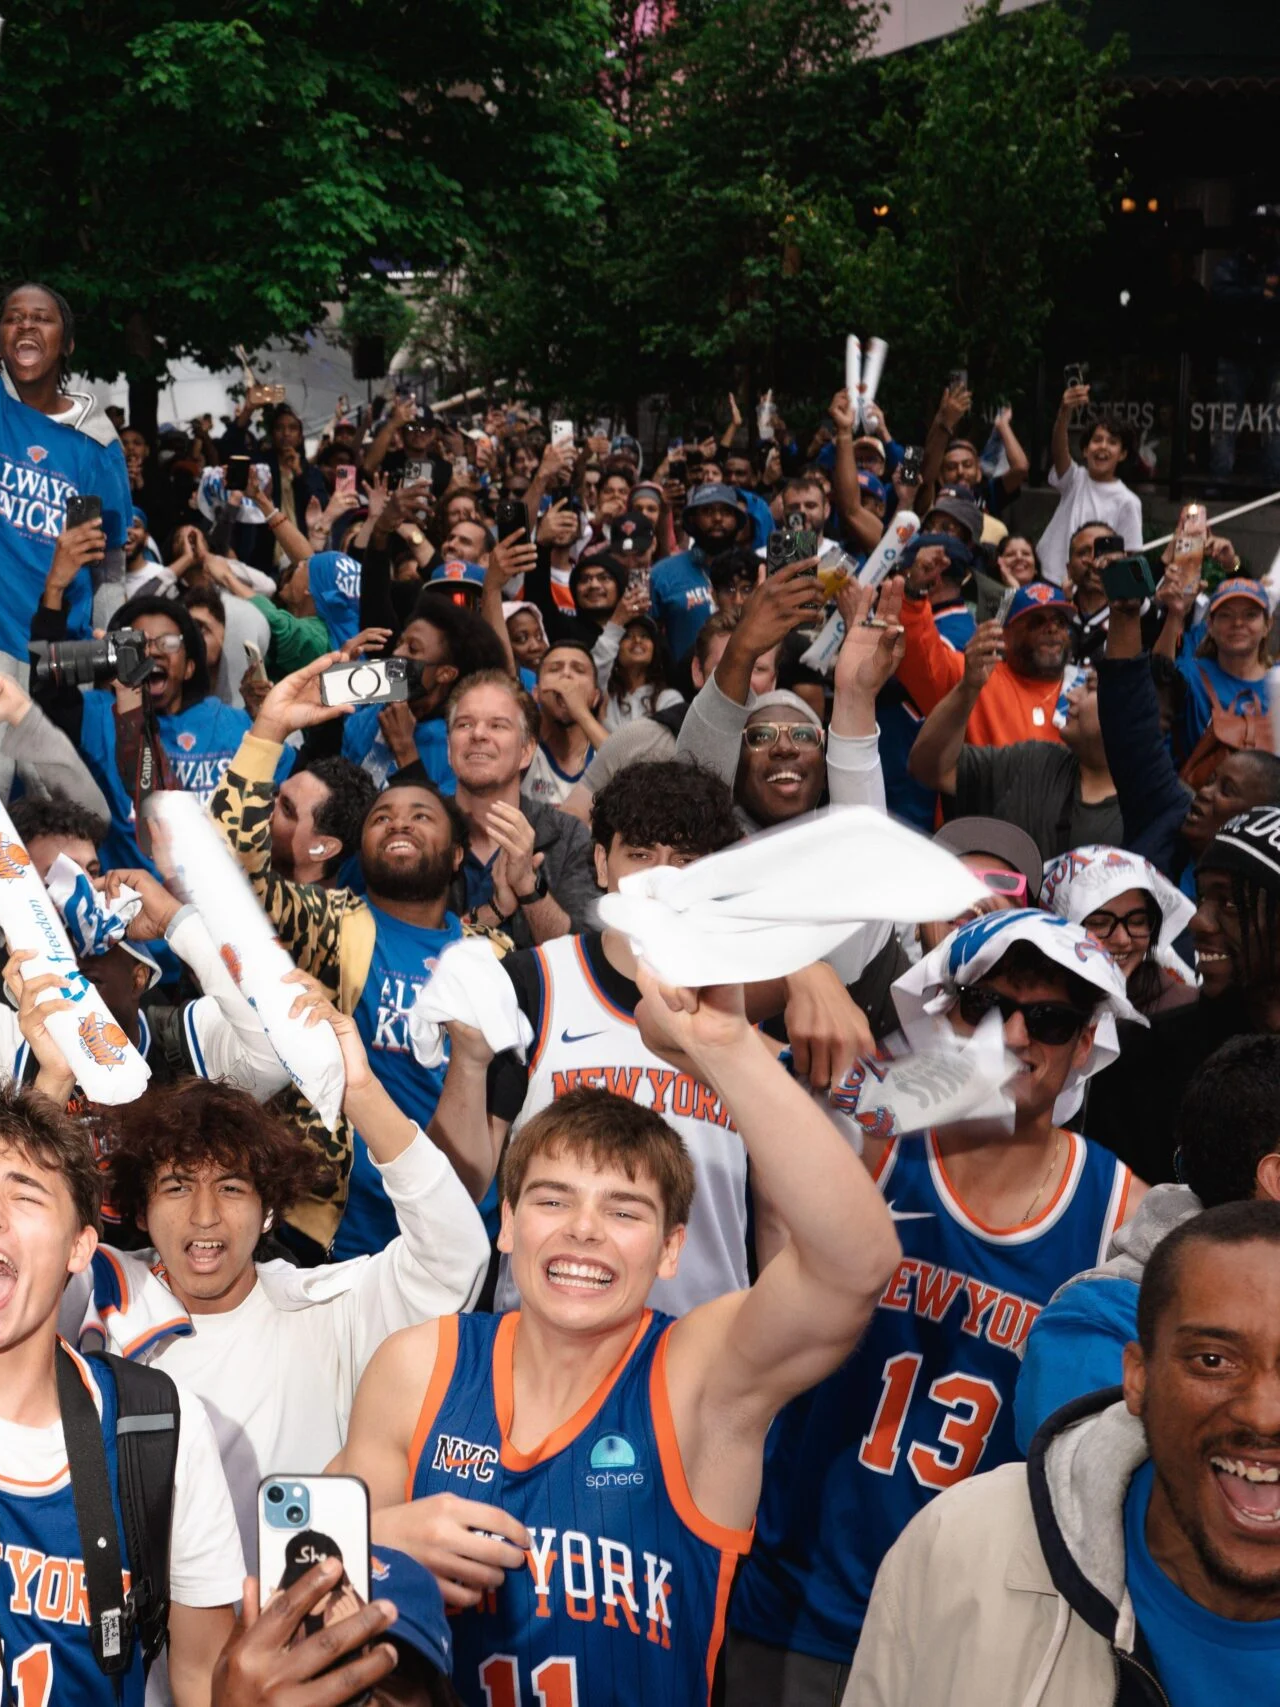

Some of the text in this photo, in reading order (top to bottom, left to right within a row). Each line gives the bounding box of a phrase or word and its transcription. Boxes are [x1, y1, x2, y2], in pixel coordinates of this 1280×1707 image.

[140, 747, 152, 790] Canon
[28, 898, 74, 963] freedom
[878, 1257, 1041, 1351] EW YO
[432, 1433, 499, 1483] NYC
[858, 1351, 1003, 1492] 13
[586, 1472, 644, 1489] sphere
[4, 1543, 132, 1626] YOR
[526, 1527, 672, 1650] YORK
